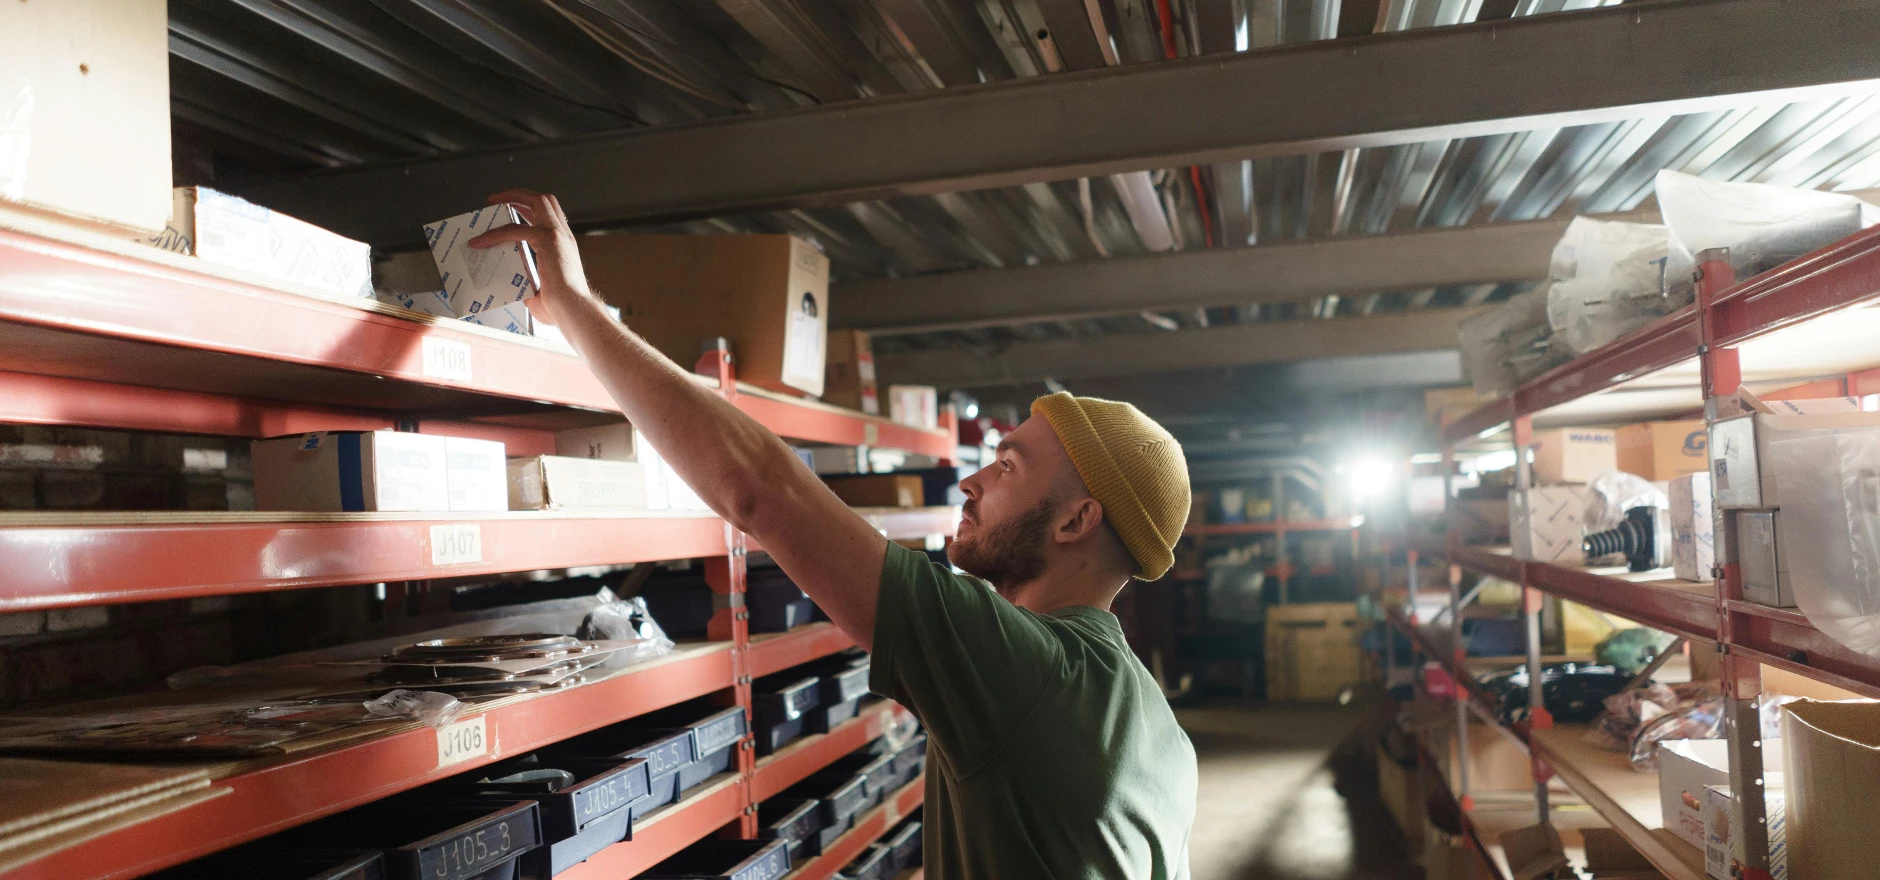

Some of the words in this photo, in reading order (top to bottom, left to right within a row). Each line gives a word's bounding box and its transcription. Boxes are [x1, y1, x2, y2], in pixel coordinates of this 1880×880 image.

[468, 209, 483, 229] KNORR-
[429, 345, 466, 372] J108
[439, 531, 475, 557] J107
[444, 725, 482, 758] J106
[651, 742, 680, 774] 05_5
[584, 774, 633, 815] J105_4
[1771, 817, 1785, 831] WAB
[436, 821, 511, 877] J105_3
[1768, 840, 1786, 857] WABC
[1770, 864, 1785, 879] ABCO
